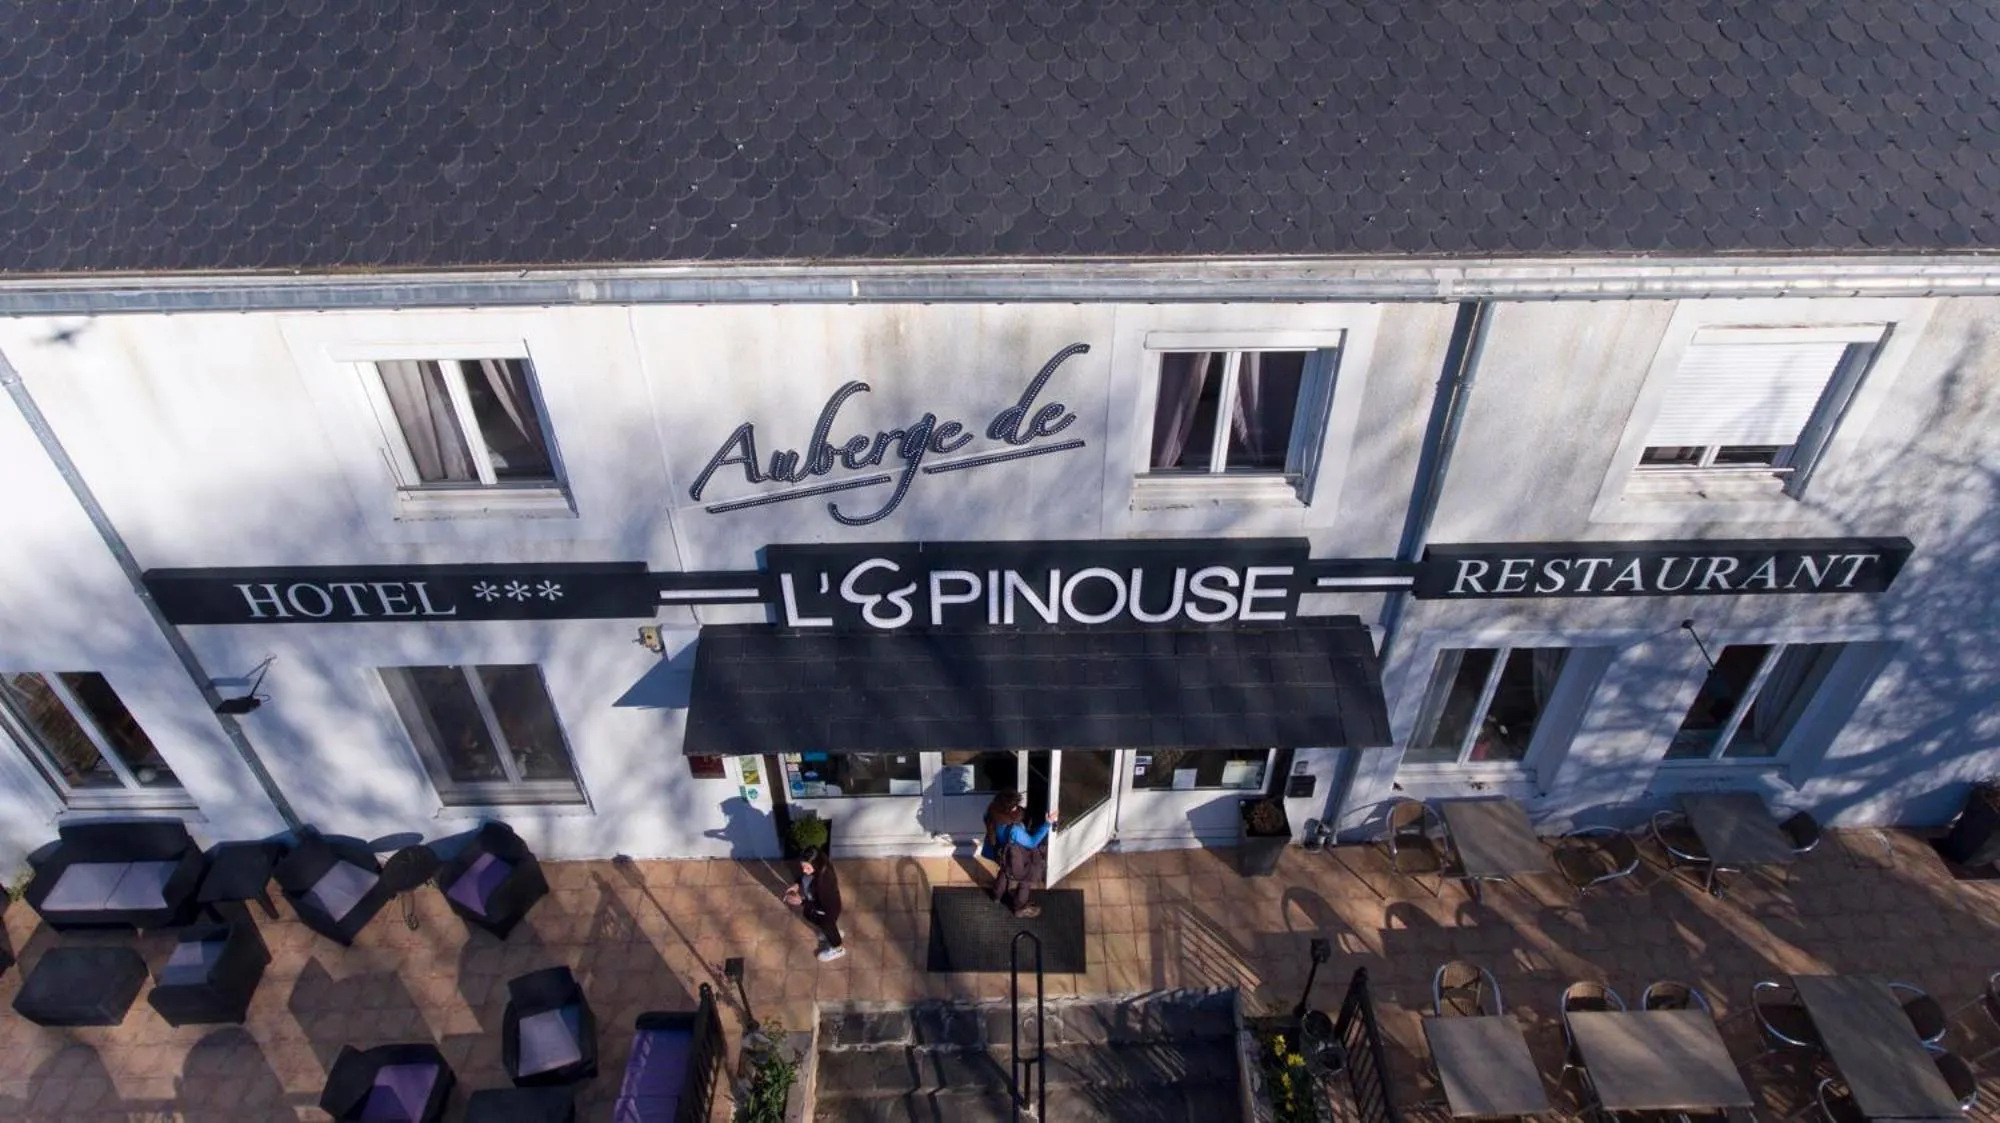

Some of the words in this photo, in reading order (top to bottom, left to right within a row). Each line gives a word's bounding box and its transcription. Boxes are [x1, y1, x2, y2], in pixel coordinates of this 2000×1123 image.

[688, 380, 975, 527] Auberge
[985, 342, 1092, 446] de
[1447, 553, 1880, 595] RESTAURANT
[232, 580, 458, 619] HOTEL
